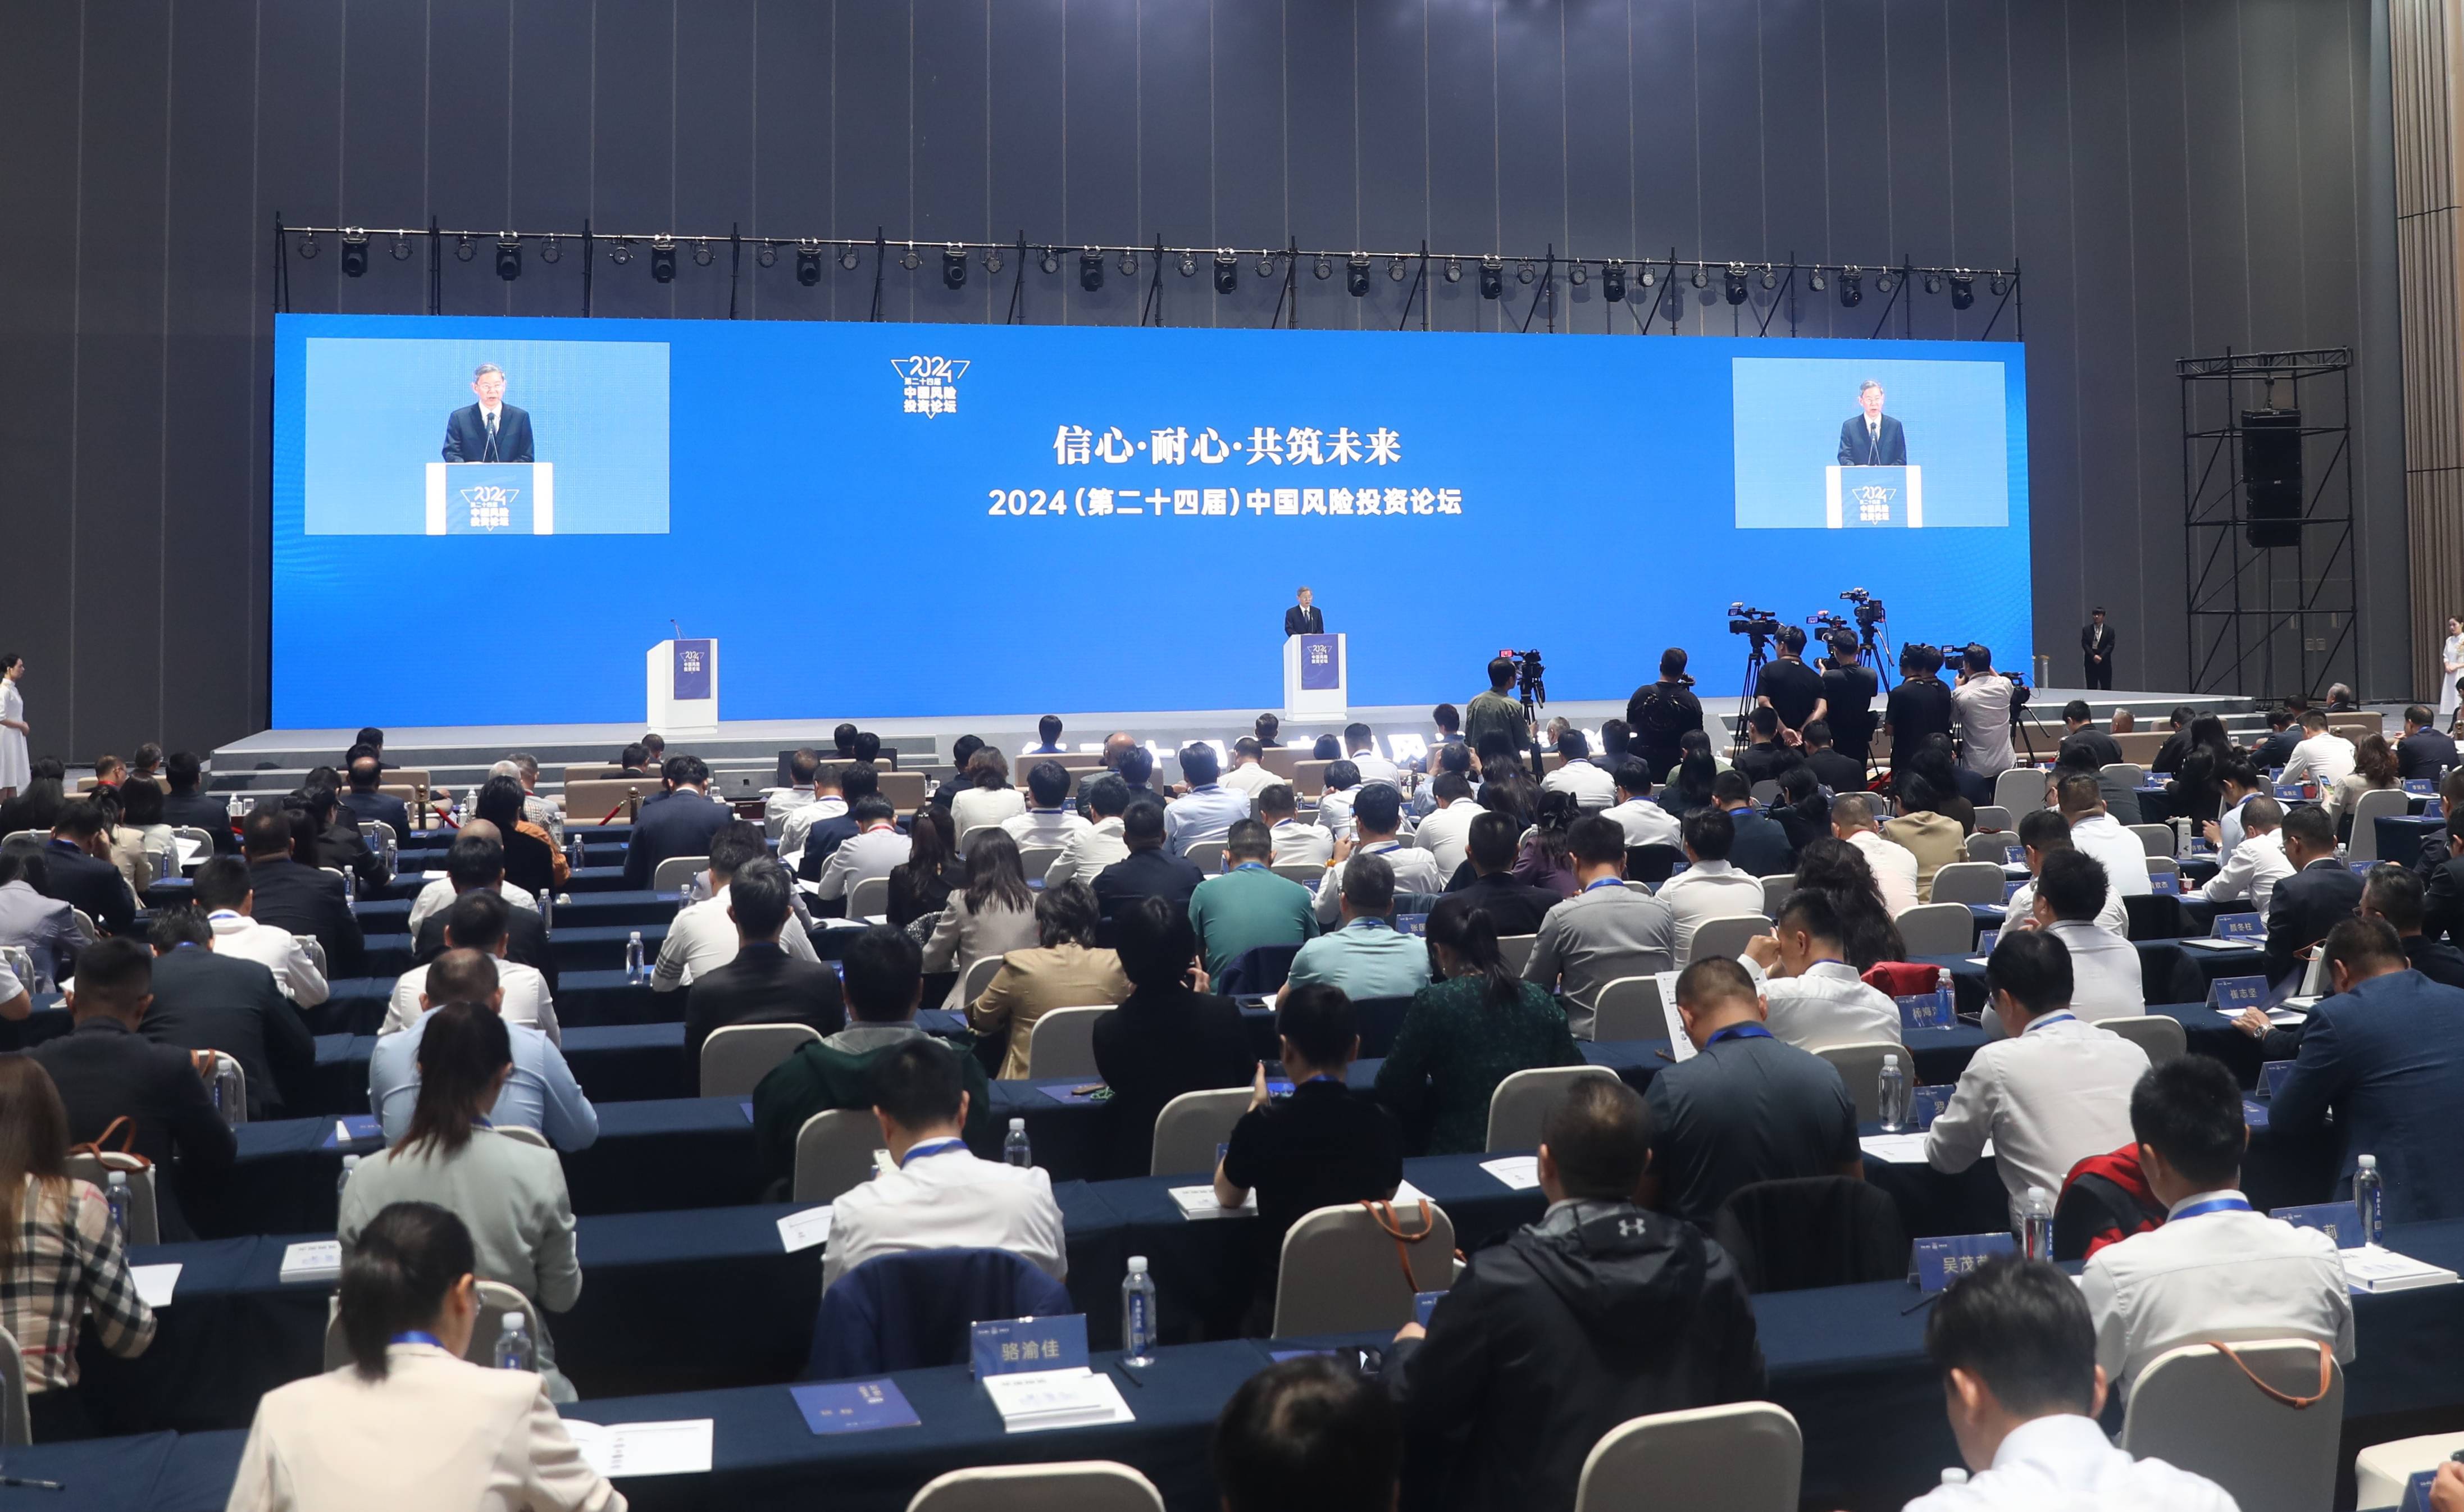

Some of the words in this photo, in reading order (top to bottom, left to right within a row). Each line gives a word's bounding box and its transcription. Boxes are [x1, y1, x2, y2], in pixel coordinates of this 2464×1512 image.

[909, 356, 952, 383] 2024
[904, 386, 957, 399] 中国风险
[904, 399, 957, 413] 投资论坛
[2230, 988, 2257, 999] 崔志坚
[1001, 1339, 1060, 1361] 骆渝佳
